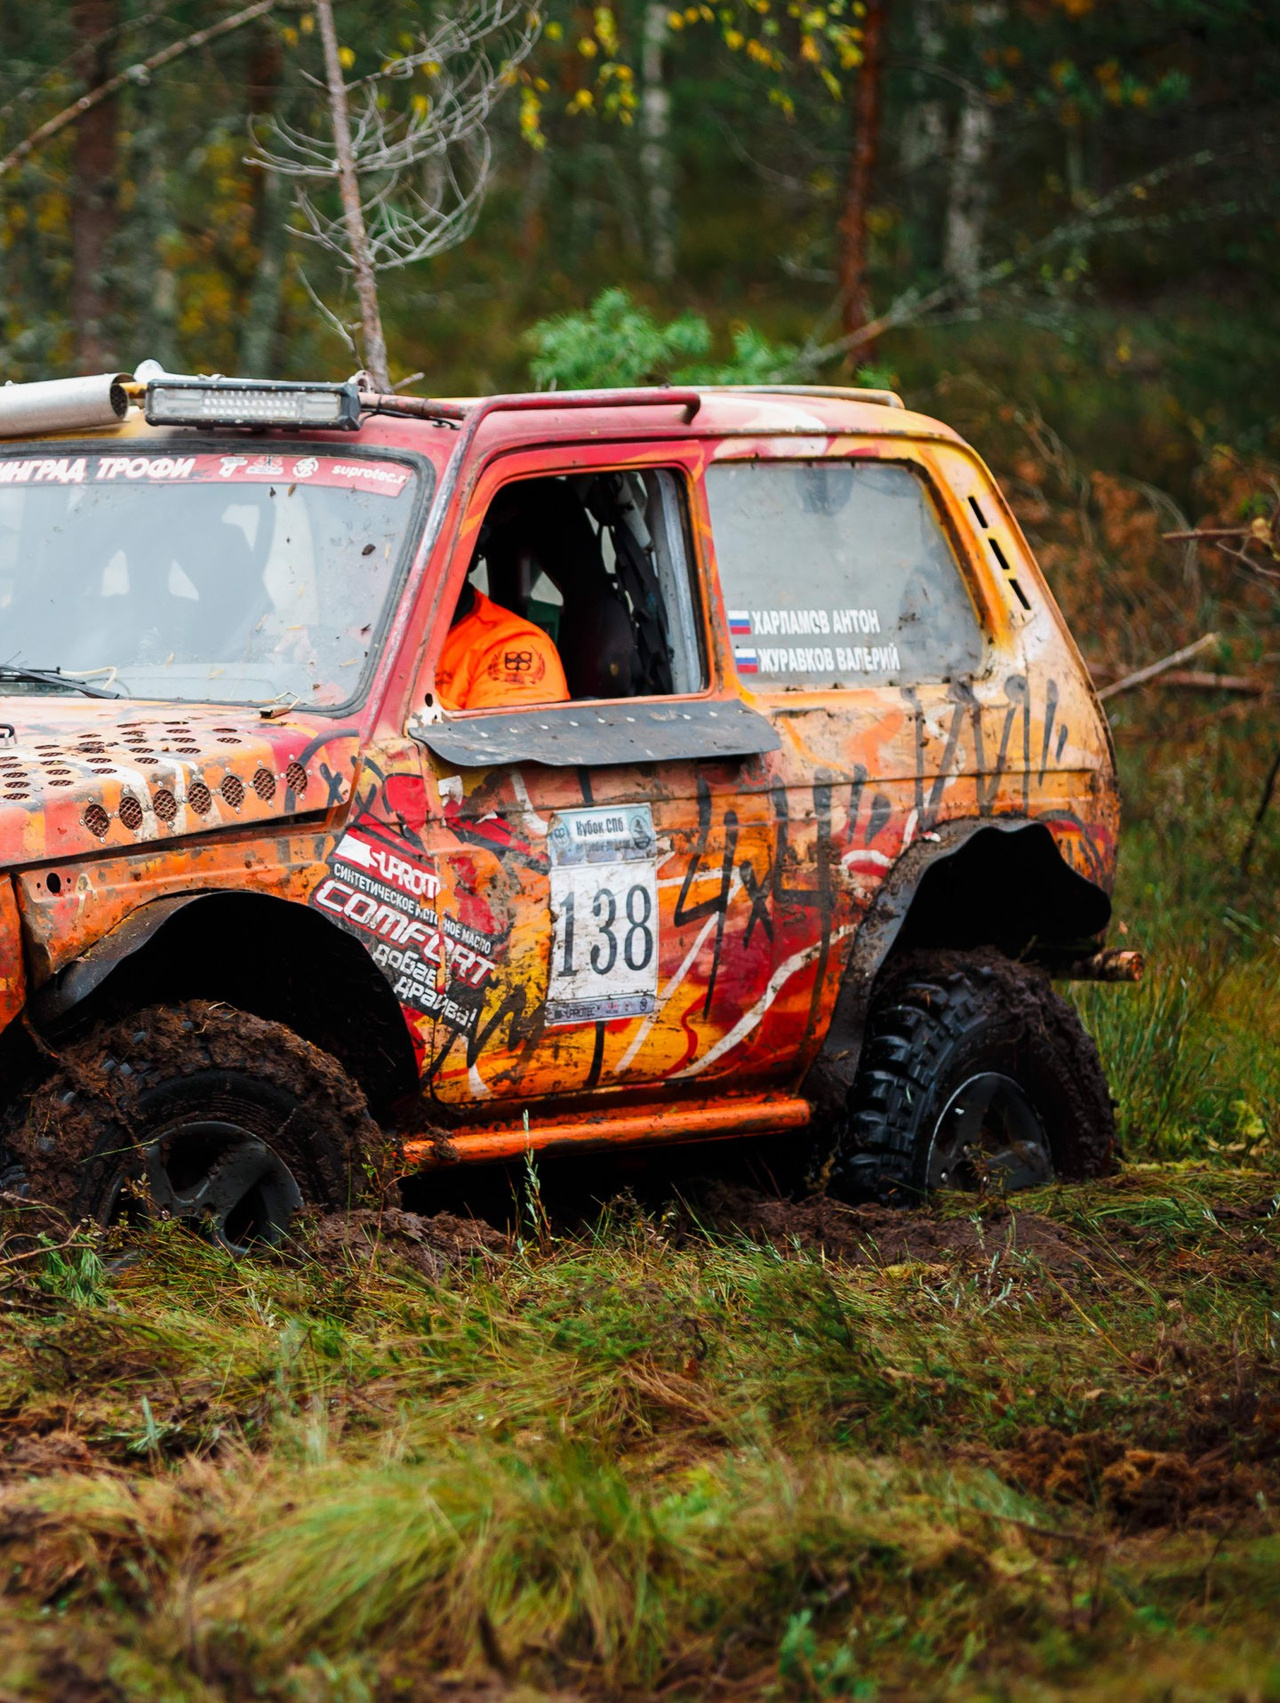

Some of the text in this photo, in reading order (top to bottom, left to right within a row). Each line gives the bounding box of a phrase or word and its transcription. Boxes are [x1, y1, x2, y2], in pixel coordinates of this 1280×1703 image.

[96, 456, 196, 480] ТРОФИ
[751, 609, 881, 635] ХАРЛАМОВ АНТОН
[756, 642, 901, 673] ЖУРАВКОВ ВАЛЕРИЙ
[576, 817, 624, 837] Кубок СПб
[333, 862, 415, 914] СИНТЕТИЧЕСКОЕ
[315, 879, 496, 985] COMFORT
[558, 883, 654, 978] 138
